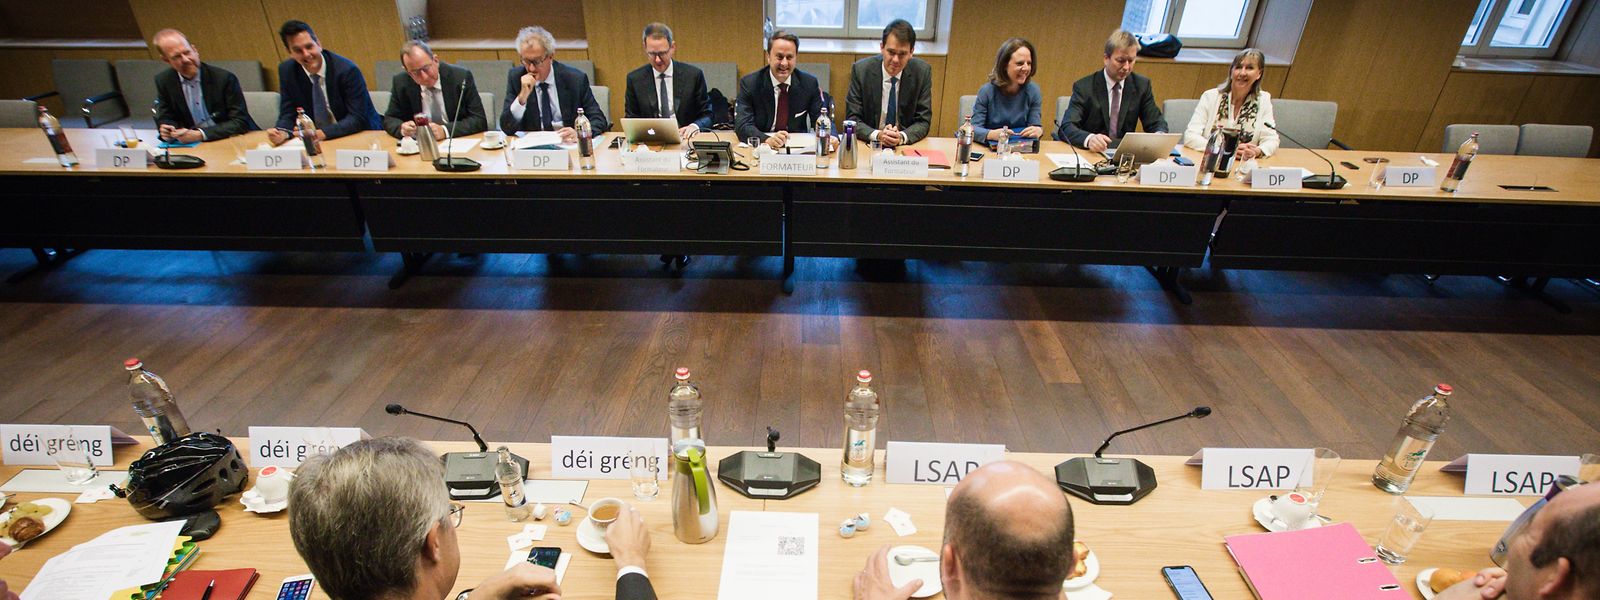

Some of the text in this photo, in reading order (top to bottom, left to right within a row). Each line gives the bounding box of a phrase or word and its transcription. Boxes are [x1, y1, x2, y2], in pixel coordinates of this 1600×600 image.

[113, 156, 131, 167] DP
[265, 156, 282, 167] DP
[353, 156, 370, 167] DP
[532, 155, 550, 167] DP
[762, 163, 814, 171] FORMATEUR
[1002, 166, 1020, 178] DP
[1159, 171, 1177, 183] DP
[1402, 172, 1418, 184] DP
[1268, 174, 1285, 186] DP
[9, 433, 103, 457] déi gréng
[259, 439, 341, 463] déi grén
[562, 449, 660, 474] déi gréng
[1228, 465, 1290, 488] LSAP
[1491, 471, 1555, 494] LSAP
